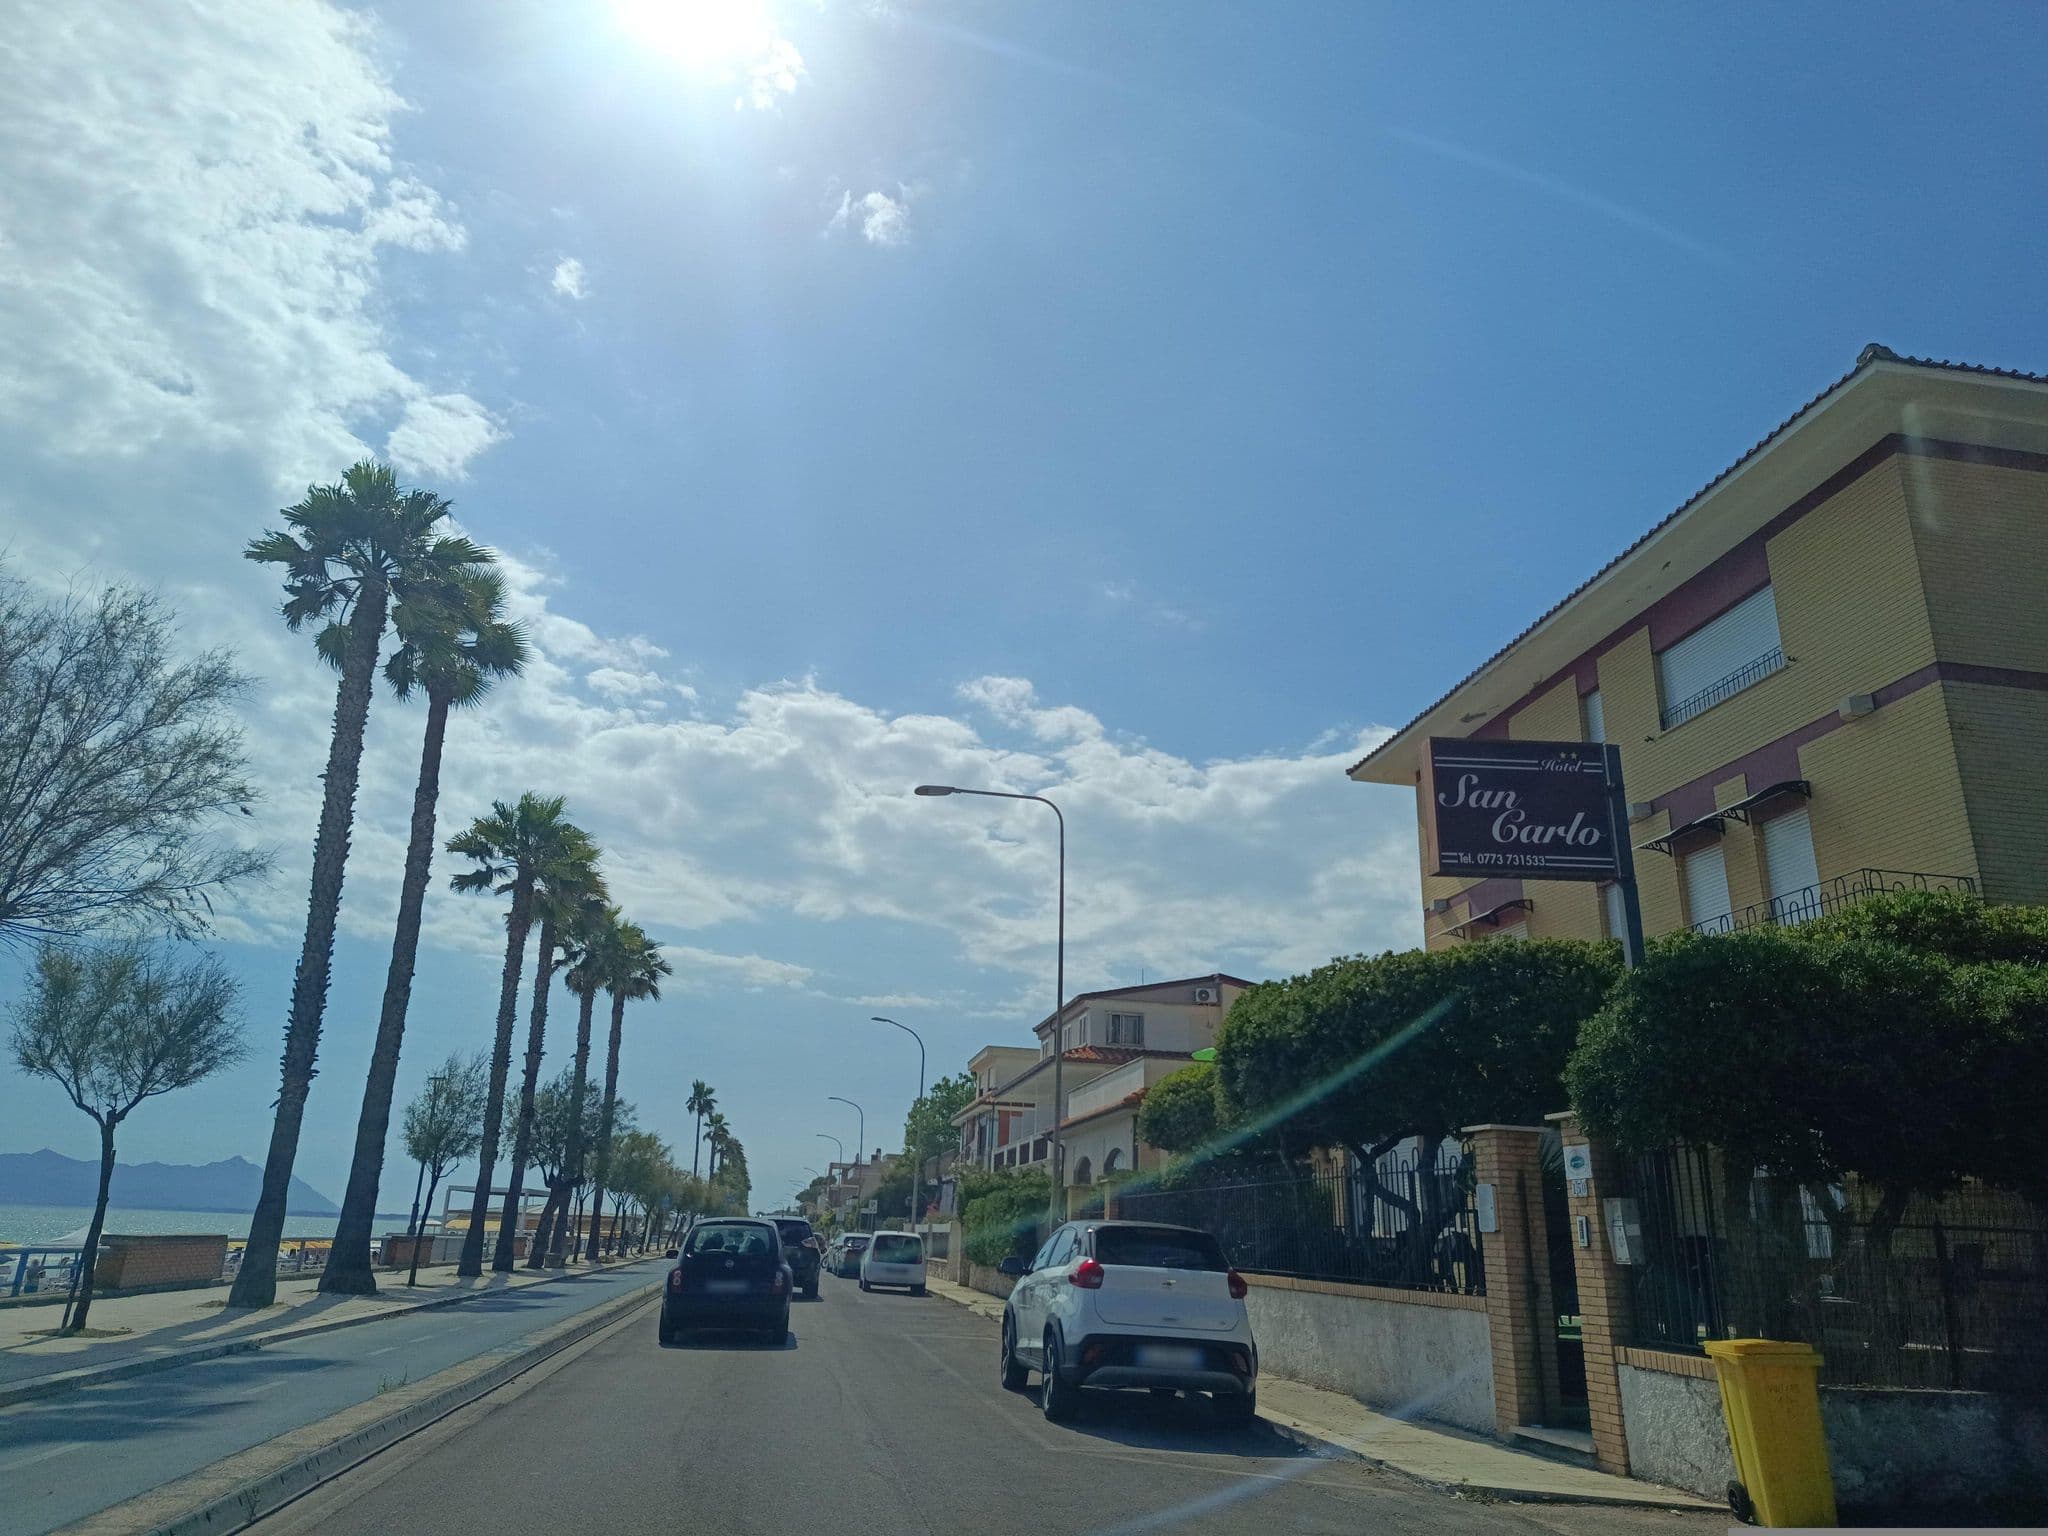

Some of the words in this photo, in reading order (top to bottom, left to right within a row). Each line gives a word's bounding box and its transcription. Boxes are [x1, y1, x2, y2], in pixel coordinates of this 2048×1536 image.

[1540, 759, 1582, 772] Hotel
[1438, 774, 1523, 809] San
[1492, 808, 1607, 846] Carlo
[1458, 853, 1474, 864] Tel.
[1477, 853, 1503, 865] 0773
[1506, 854, 1545, 866] 731533
